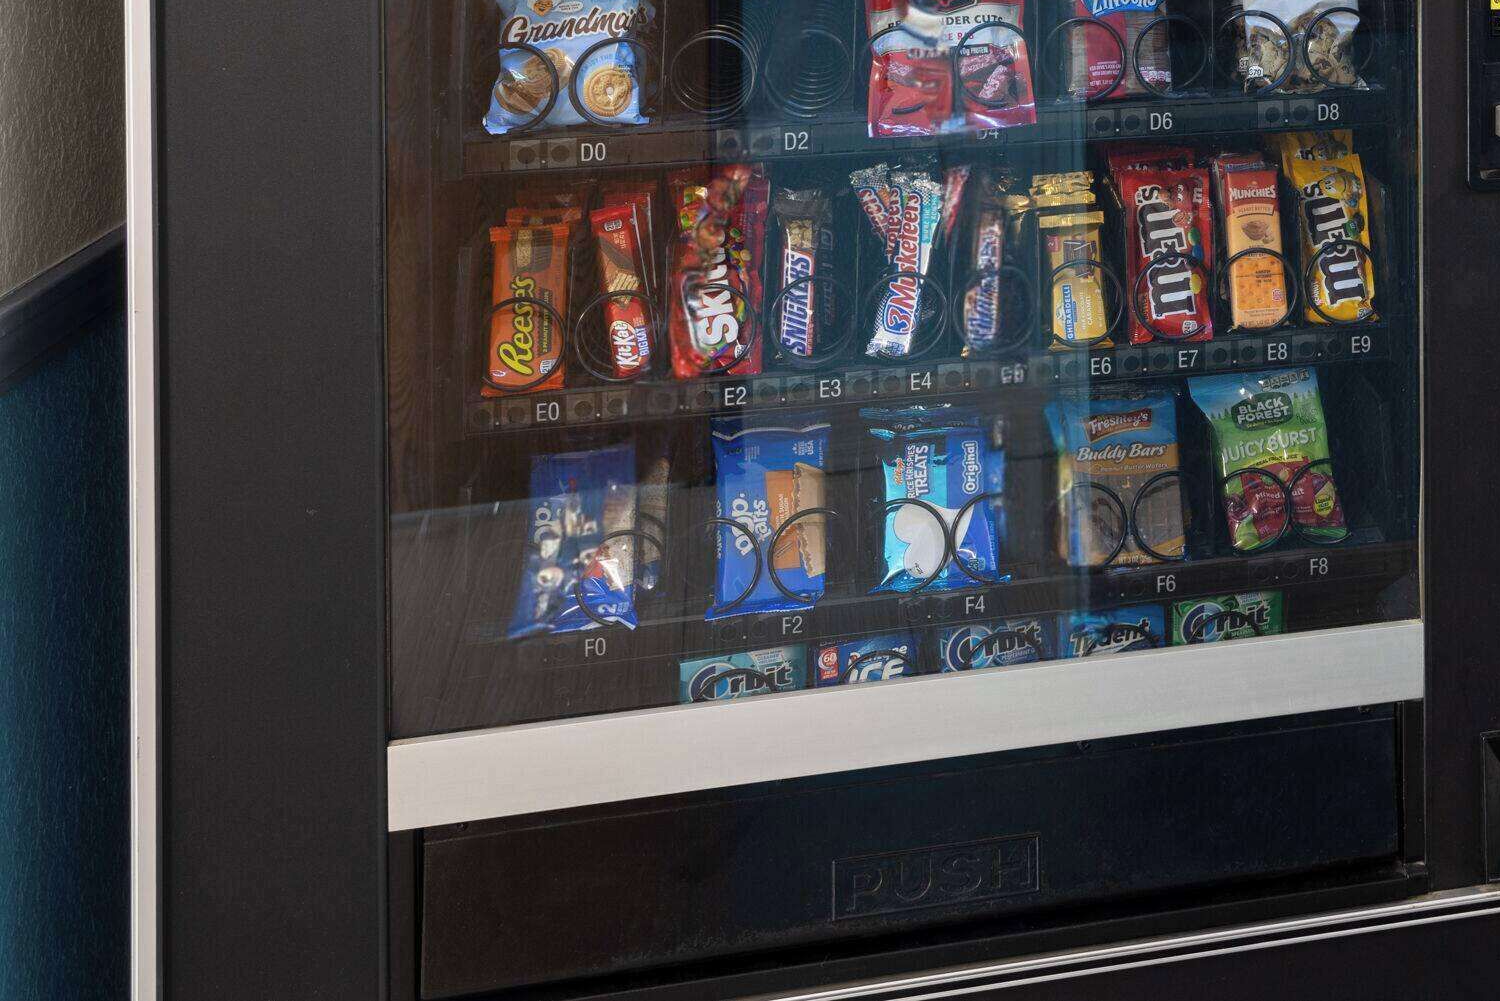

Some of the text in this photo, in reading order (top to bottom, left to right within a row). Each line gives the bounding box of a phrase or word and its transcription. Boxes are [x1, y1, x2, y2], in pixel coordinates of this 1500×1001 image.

[501, 6, 647, 44] Grandma's
[1150, 112, 1172, 130] D6
[1318, 104, 1339, 121] D8
[784, 131, 809, 150] D2
[581, 143, 606, 162] D0
[1229, 184, 1277, 201] MUNCHIES
[890, 192, 921, 312] Musketeers
[783, 250, 812, 356] SNICKERS
[1062, 285, 1075, 340] GHIRARDELLI
[499, 275, 536, 376] Reese's
[1267, 343, 1288, 361] E8
[1352, 336, 1371, 354] E9
[1091, 357, 1111, 375] E6
[1179, 350, 1198, 368] E7
[820, 379, 841, 398] E3
[911, 371, 932, 391] E4
[724, 386, 747, 406] E2
[1238, 396, 1284, 415] BLACK
[536, 402, 560, 421] E0
[1237, 406, 1290, 425] FOREST
[1077, 443, 1166, 463] Buddy Bars
[1222, 427, 1317, 464] JUICY BURST
[914, 445, 929, 495] TREATS
[963, 441, 981, 493] Original
[1255, 491, 1280, 501] Mixed
[1310, 557, 1329, 575] F8
[1157, 575, 1176, 592] F6
[965, 595, 985, 614] F4
[782, 616, 803, 635] F2
[1181, 601, 1271, 646] Orbit
[584, 638, 606, 656] F0
[690, 662, 792, 704] Orbit
[847, 839, 1032, 911] PUSH
